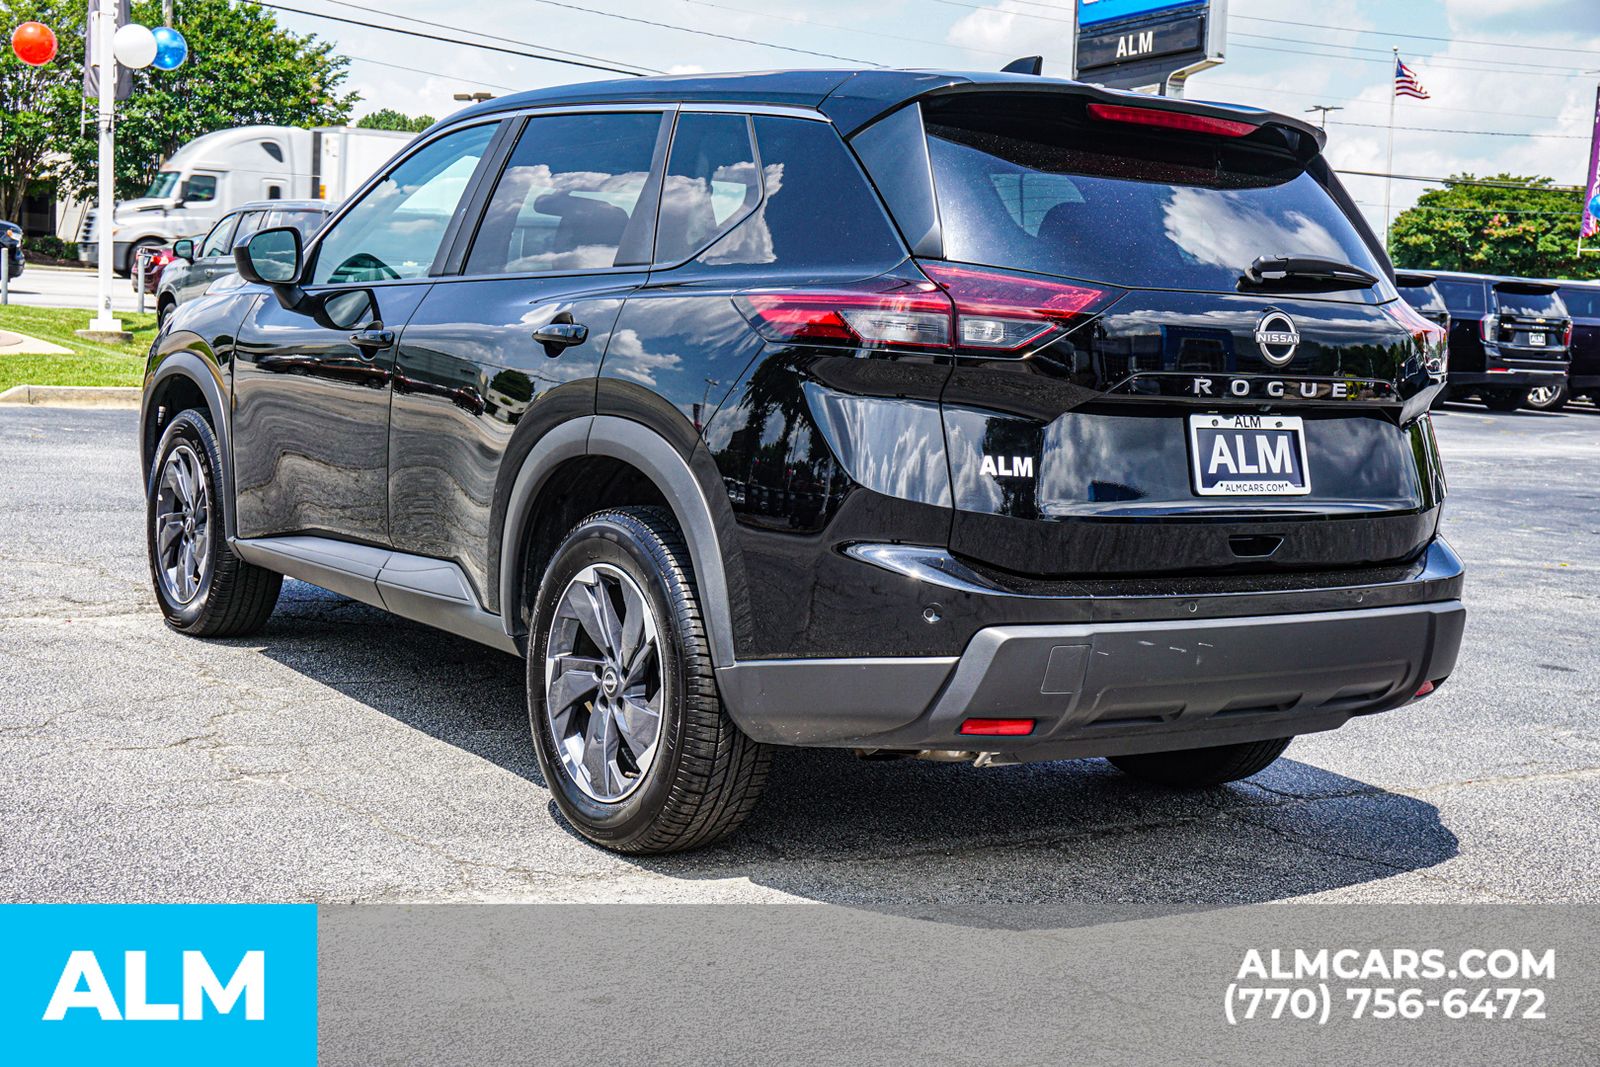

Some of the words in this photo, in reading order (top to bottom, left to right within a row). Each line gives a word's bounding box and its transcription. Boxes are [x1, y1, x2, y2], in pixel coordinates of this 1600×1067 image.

[1116, 31, 1153, 58] ALM
[1257, 333, 1300, 344] NISSAN
[1193, 377, 1348, 398] ROGUE
[1234, 415, 1262, 428] ALM
[1208, 434, 1293, 474] ALM
[979, 455, 1034, 478] ALM
[1225, 483, 1285, 493] ALMCARS.COM
